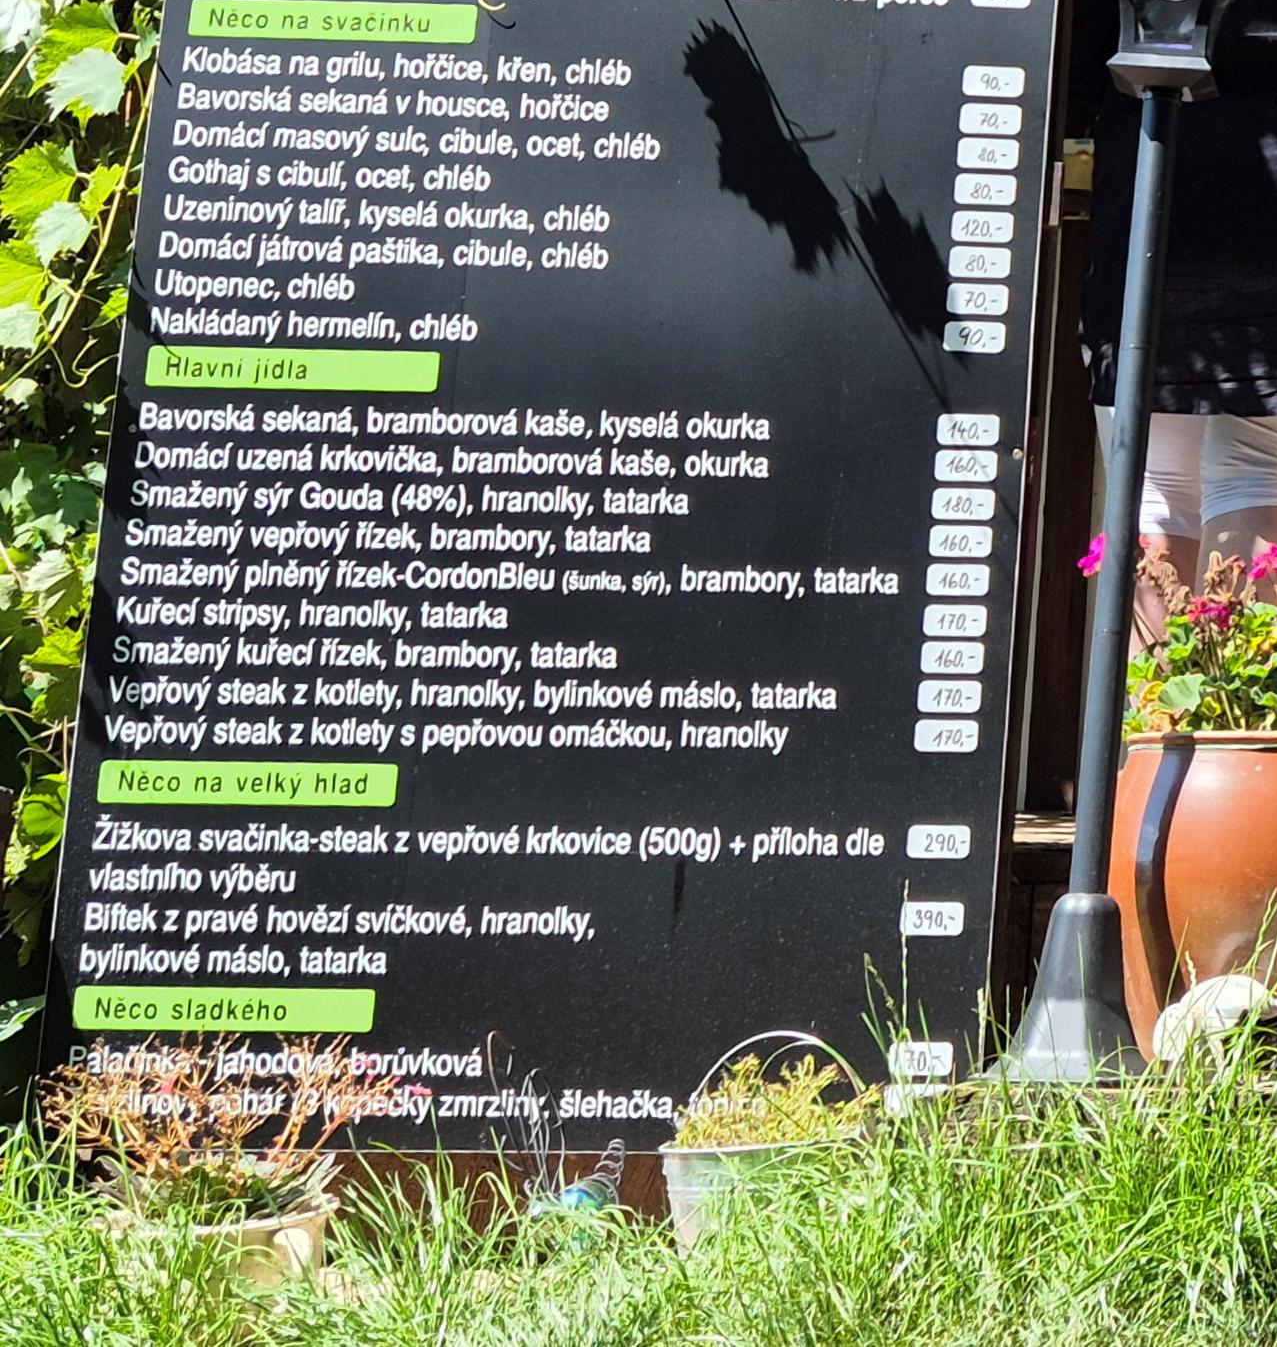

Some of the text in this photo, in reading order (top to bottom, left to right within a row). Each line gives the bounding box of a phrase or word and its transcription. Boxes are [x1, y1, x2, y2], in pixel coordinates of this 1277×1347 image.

[209, 9, 430, 32] Něco na svačinku
[183, 46, 631, 86] Klobása na grilu, hořčice, křen, chléb
[169, 156, 491, 193] Gothaj s cibulí, ocet, chléb
[131, 480, 689, 520] Smažený sýr Gouda (48%), hranolky, tatarka
[119, 770, 368, 799] Něco na velký hlad
[92, 814, 884, 862] Žižkova svačinka-steak z vepřové krkovice (500g) + příloha dle
[90, 862, 296, 899] vlastního výběru
[84, 902, 594, 942] Biftek z pravé hovězí svíčkové, hranolky,
[95, 998, 286, 1020] Něco sladkého
